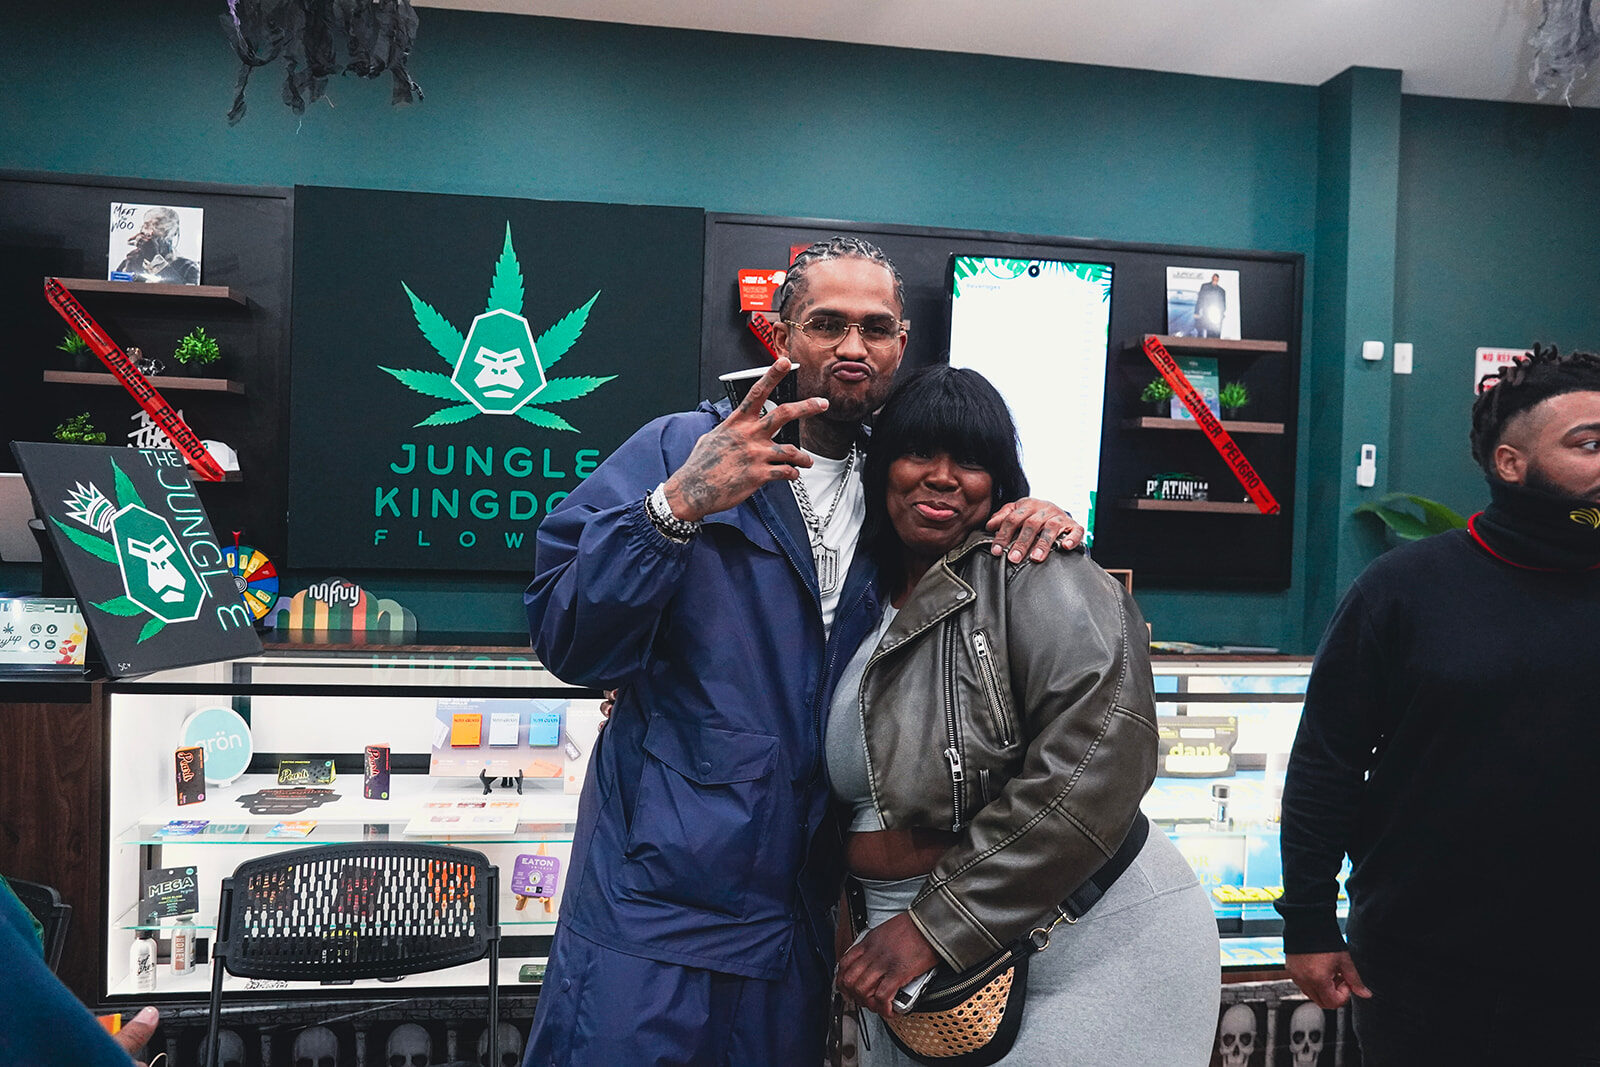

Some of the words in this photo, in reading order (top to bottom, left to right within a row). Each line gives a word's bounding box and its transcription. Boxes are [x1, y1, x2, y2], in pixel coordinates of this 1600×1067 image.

[104, 348, 156, 403] DANGER
[154, 406, 205, 460] PELIGRO
[1184, 389, 1223, 438] DANGER
[1221, 441, 1260, 490] PELIGRO
[139, 449, 182, 467] THE
[390, 444, 600, 479] JUNGLE
[521, 857, 554, 867] EATON
[148, 876, 195, 898] MEGA
[176, 936, 185, 961] HONEY
